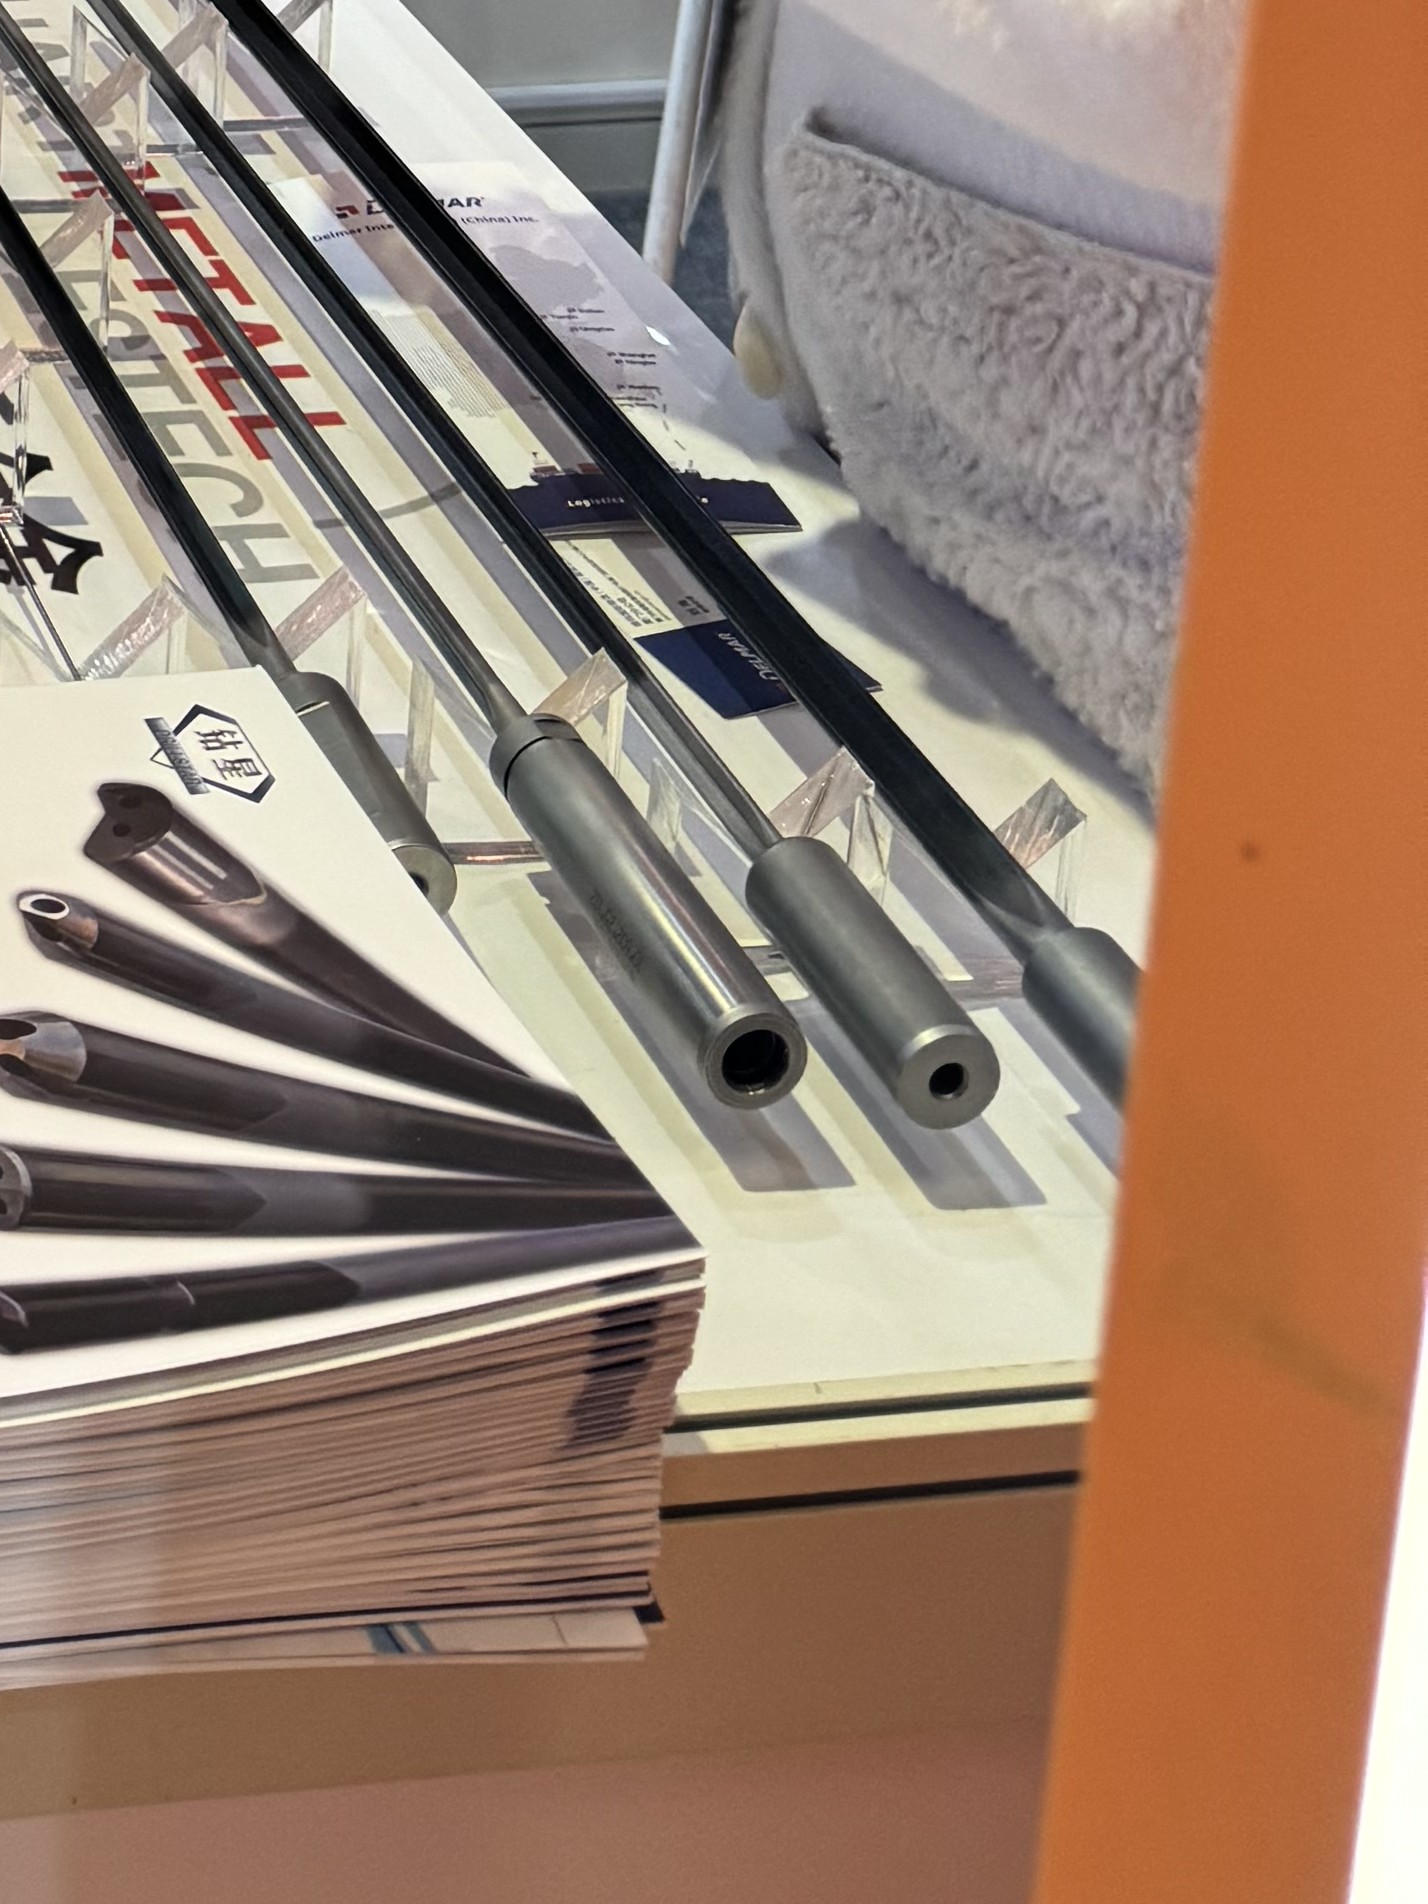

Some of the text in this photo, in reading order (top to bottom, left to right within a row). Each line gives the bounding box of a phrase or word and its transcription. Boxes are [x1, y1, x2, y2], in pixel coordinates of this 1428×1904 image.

[312, 214, 540, 242] Delmar (China) Inc.
[567, 495, 625, 508] Logistics
[718, 632, 780, 681] DELMAR
[192, 727, 264, 781] 钻星
